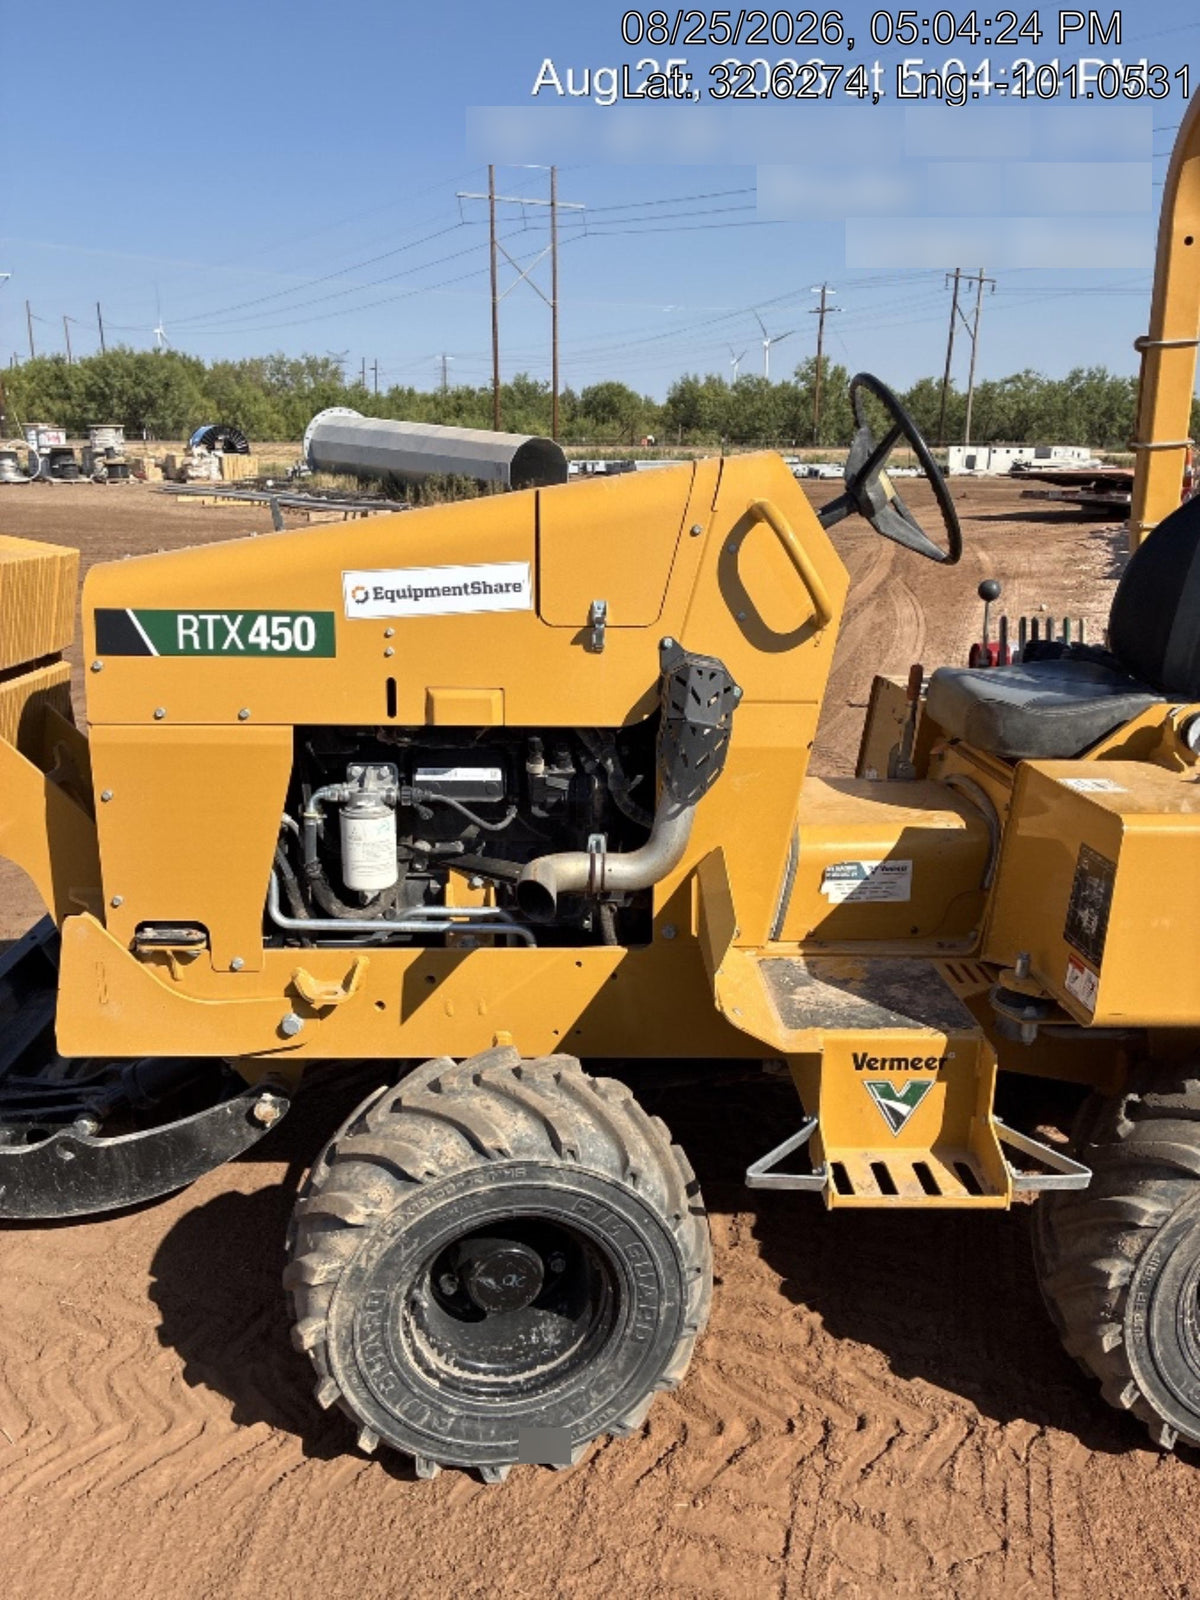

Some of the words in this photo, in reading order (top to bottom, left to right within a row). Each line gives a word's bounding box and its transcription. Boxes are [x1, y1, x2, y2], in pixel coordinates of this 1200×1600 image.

[372, 580, 523, 603] EquipmentShare
[176, 614, 316, 652] RTX450
[852, 1052, 948, 1071] Vermeer
